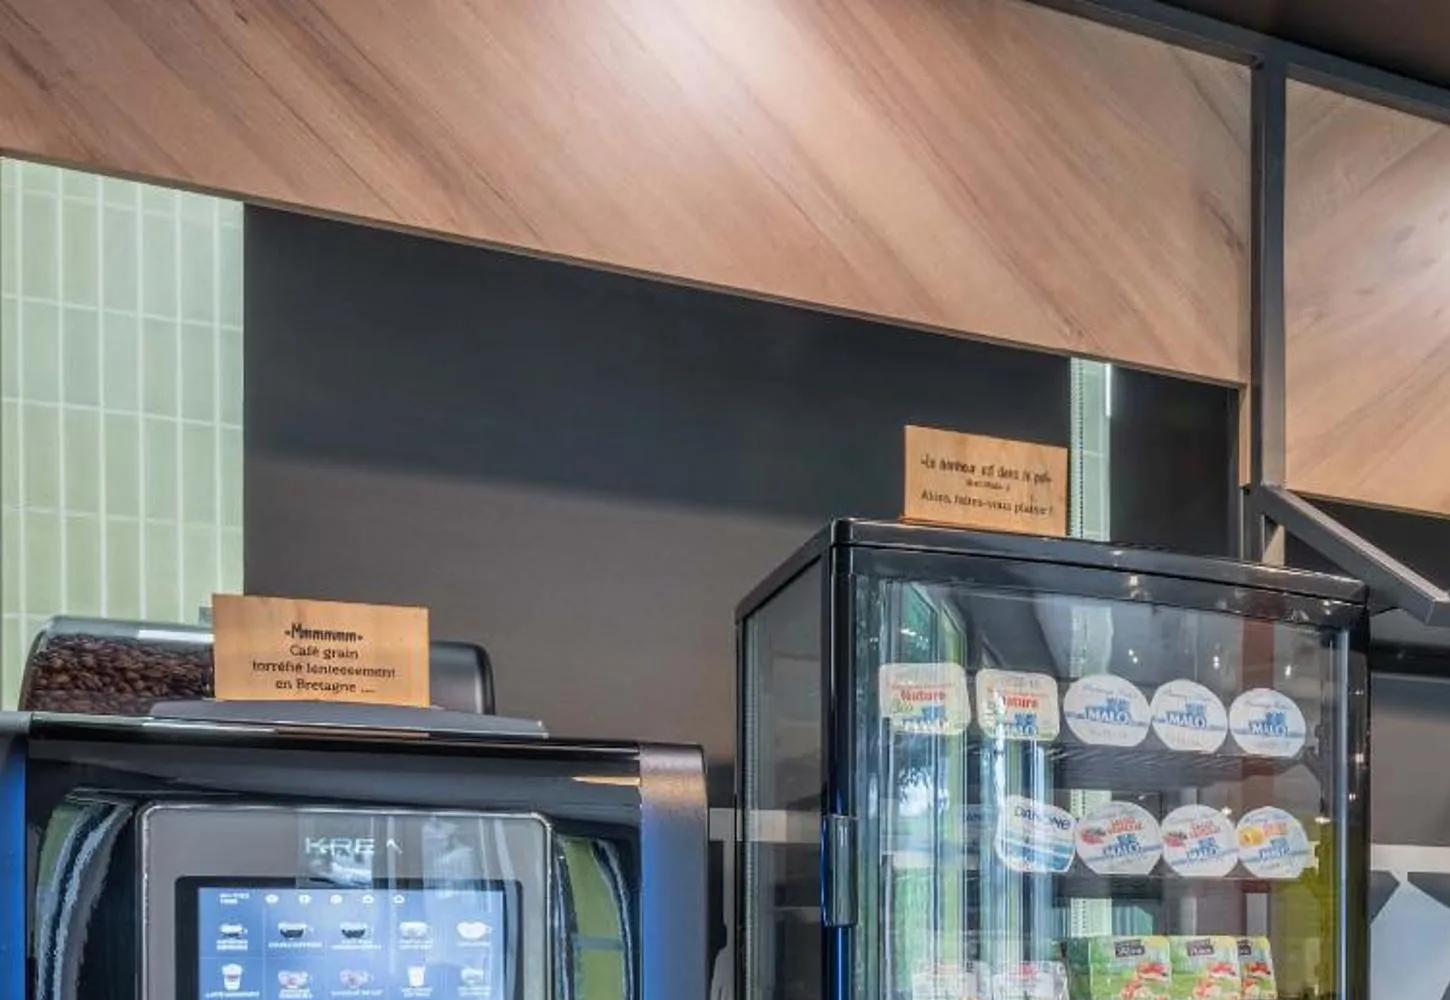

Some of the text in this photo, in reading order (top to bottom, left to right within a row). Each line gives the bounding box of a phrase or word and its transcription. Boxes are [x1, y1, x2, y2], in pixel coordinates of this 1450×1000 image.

[289, 643, 359, 661] Café grain
[252, 660, 303, 675] torréfié
[275, 680, 292, 691] en
[296, 678, 357, 695] Bretagne
